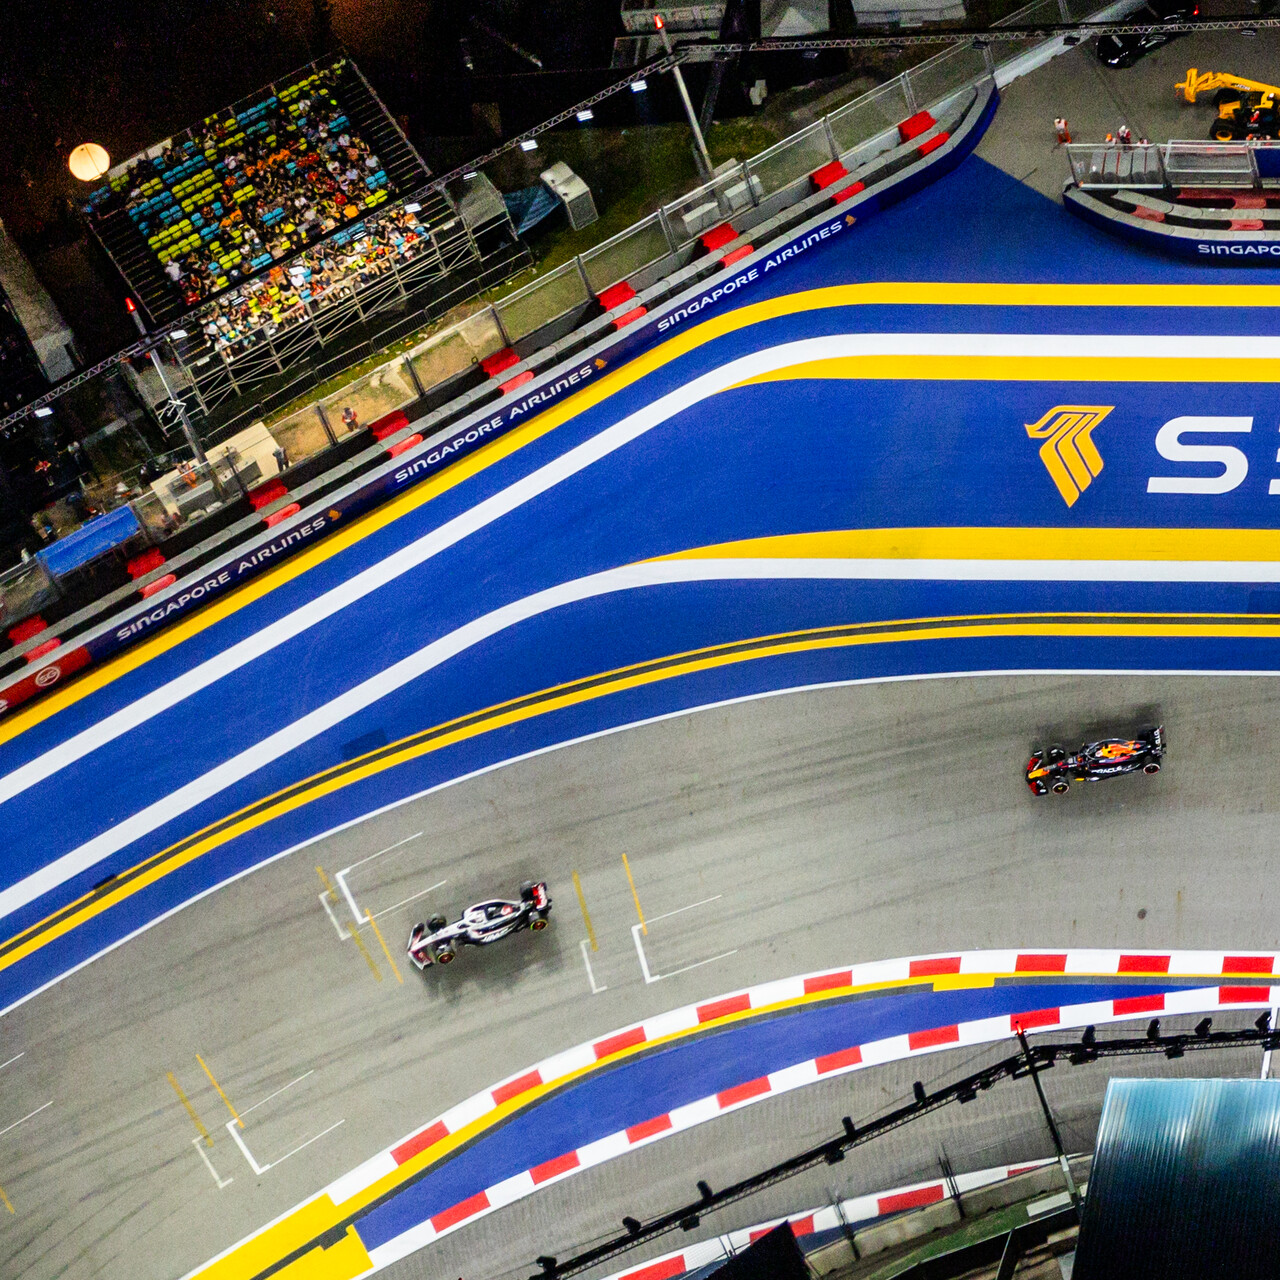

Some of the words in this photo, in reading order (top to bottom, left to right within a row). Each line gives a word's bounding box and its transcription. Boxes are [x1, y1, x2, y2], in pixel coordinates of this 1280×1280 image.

[657, 268, 760, 332] SINGAPORE
[764, 221, 843, 272] AIRLINES
[395, 416, 503, 483] SINGAPORE
[509, 365, 593, 420] AIRLINES
[116, 571, 231, 641] SINGAPORE
[238, 516, 326, 574] AIRLINES
